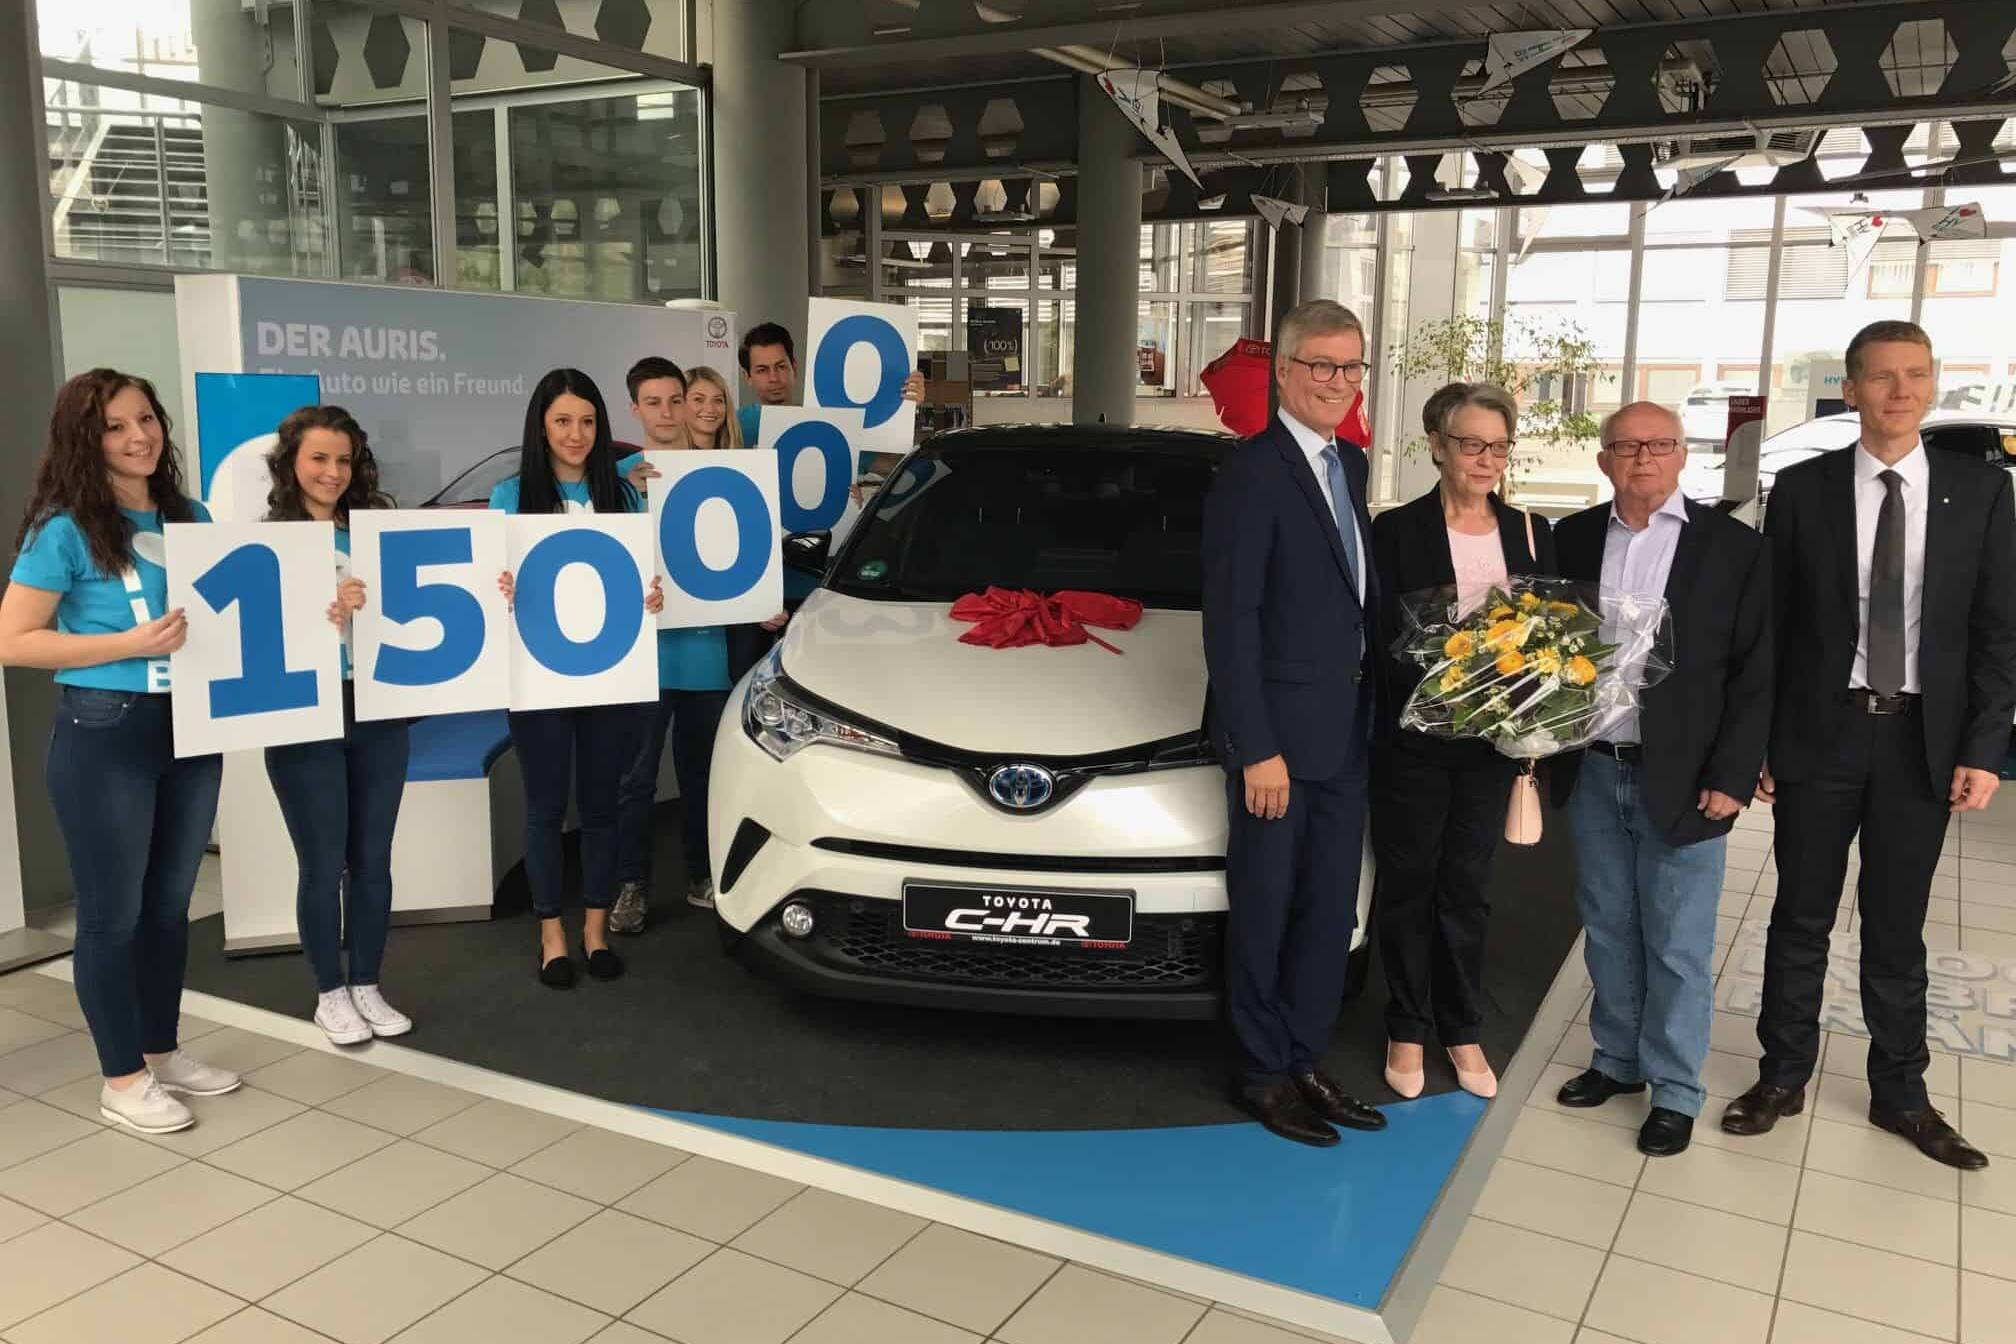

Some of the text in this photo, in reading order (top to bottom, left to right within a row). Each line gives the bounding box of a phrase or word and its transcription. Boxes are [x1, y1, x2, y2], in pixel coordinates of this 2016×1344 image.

[256, 320, 447, 362] DER AURIS.
[372, 371, 410, 393] wie
[416, 371, 449, 395] ein
[982, 895, 1053, 909] TOYOTA
[944, 908, 1091, 938] C-HR
